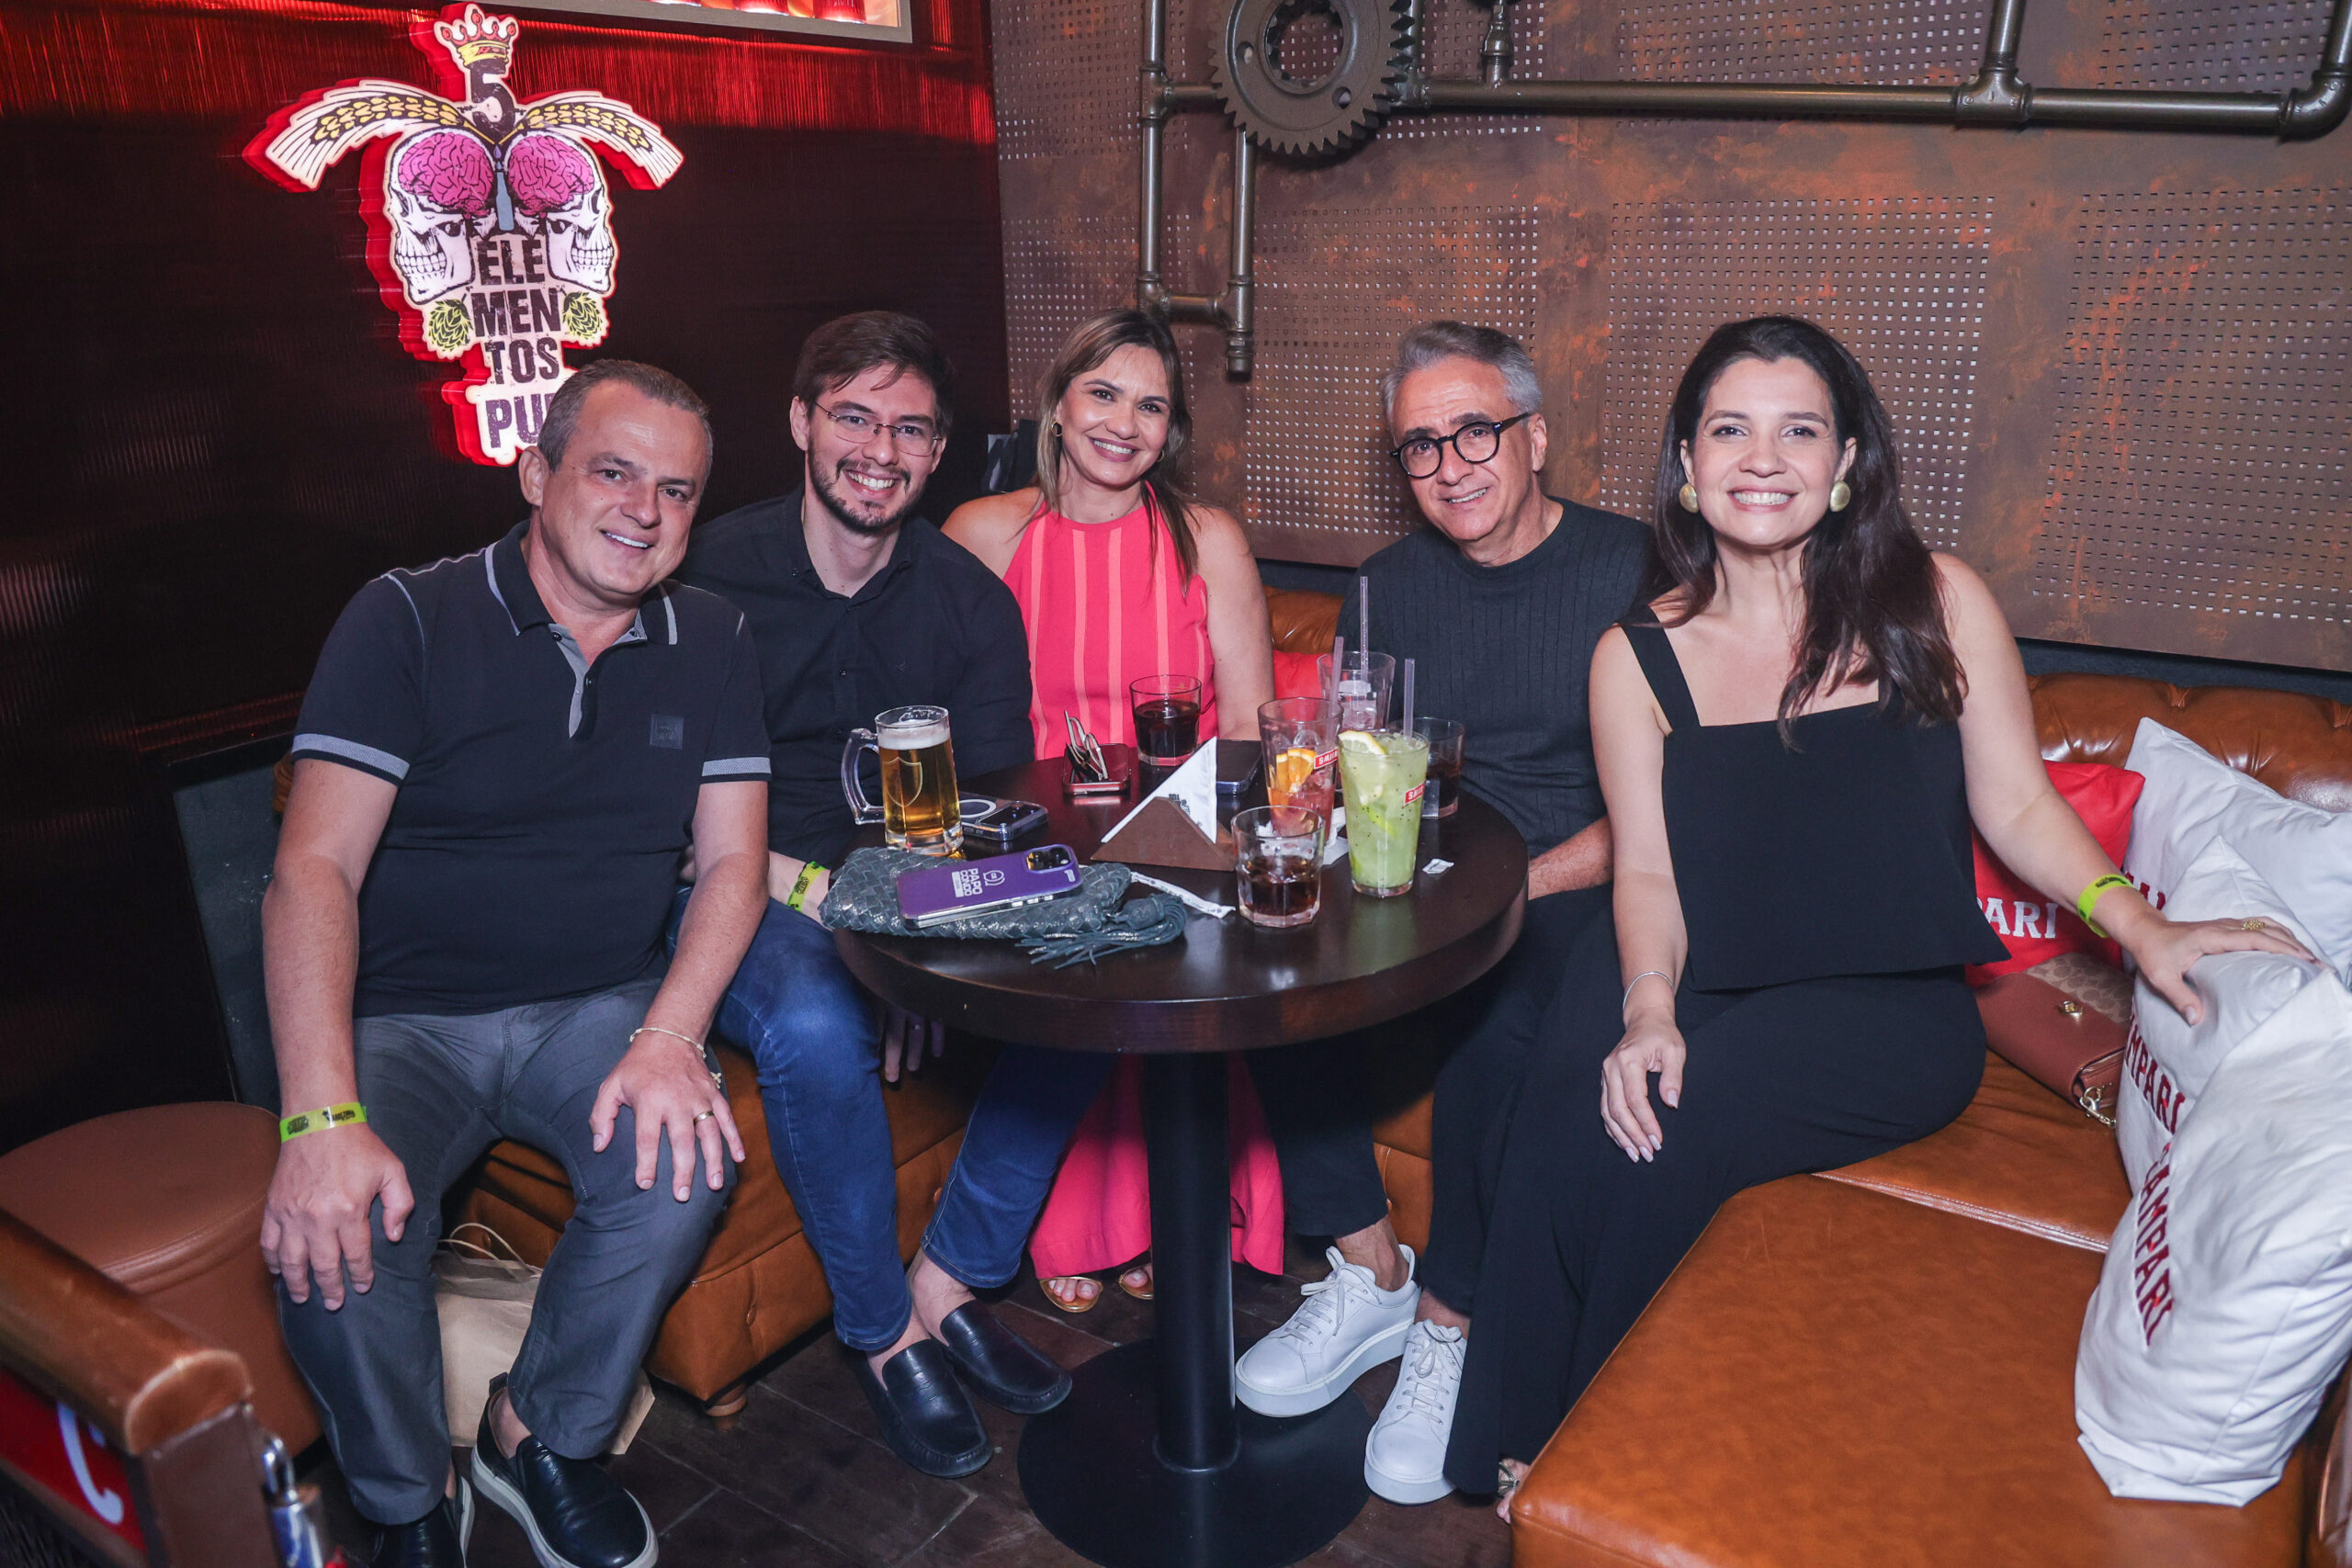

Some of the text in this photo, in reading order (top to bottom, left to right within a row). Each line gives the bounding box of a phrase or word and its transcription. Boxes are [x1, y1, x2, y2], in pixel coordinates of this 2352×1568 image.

[477, 239, 546, 286] ELE
[470, 288, 561, 337] MEN
[484, 336, 560, 385] TOS
[968, 868, 983, 895] PAPO
[1977, 897, 2059, 939] ARI
[2125, 1013, 2186, 1135] MPARI
